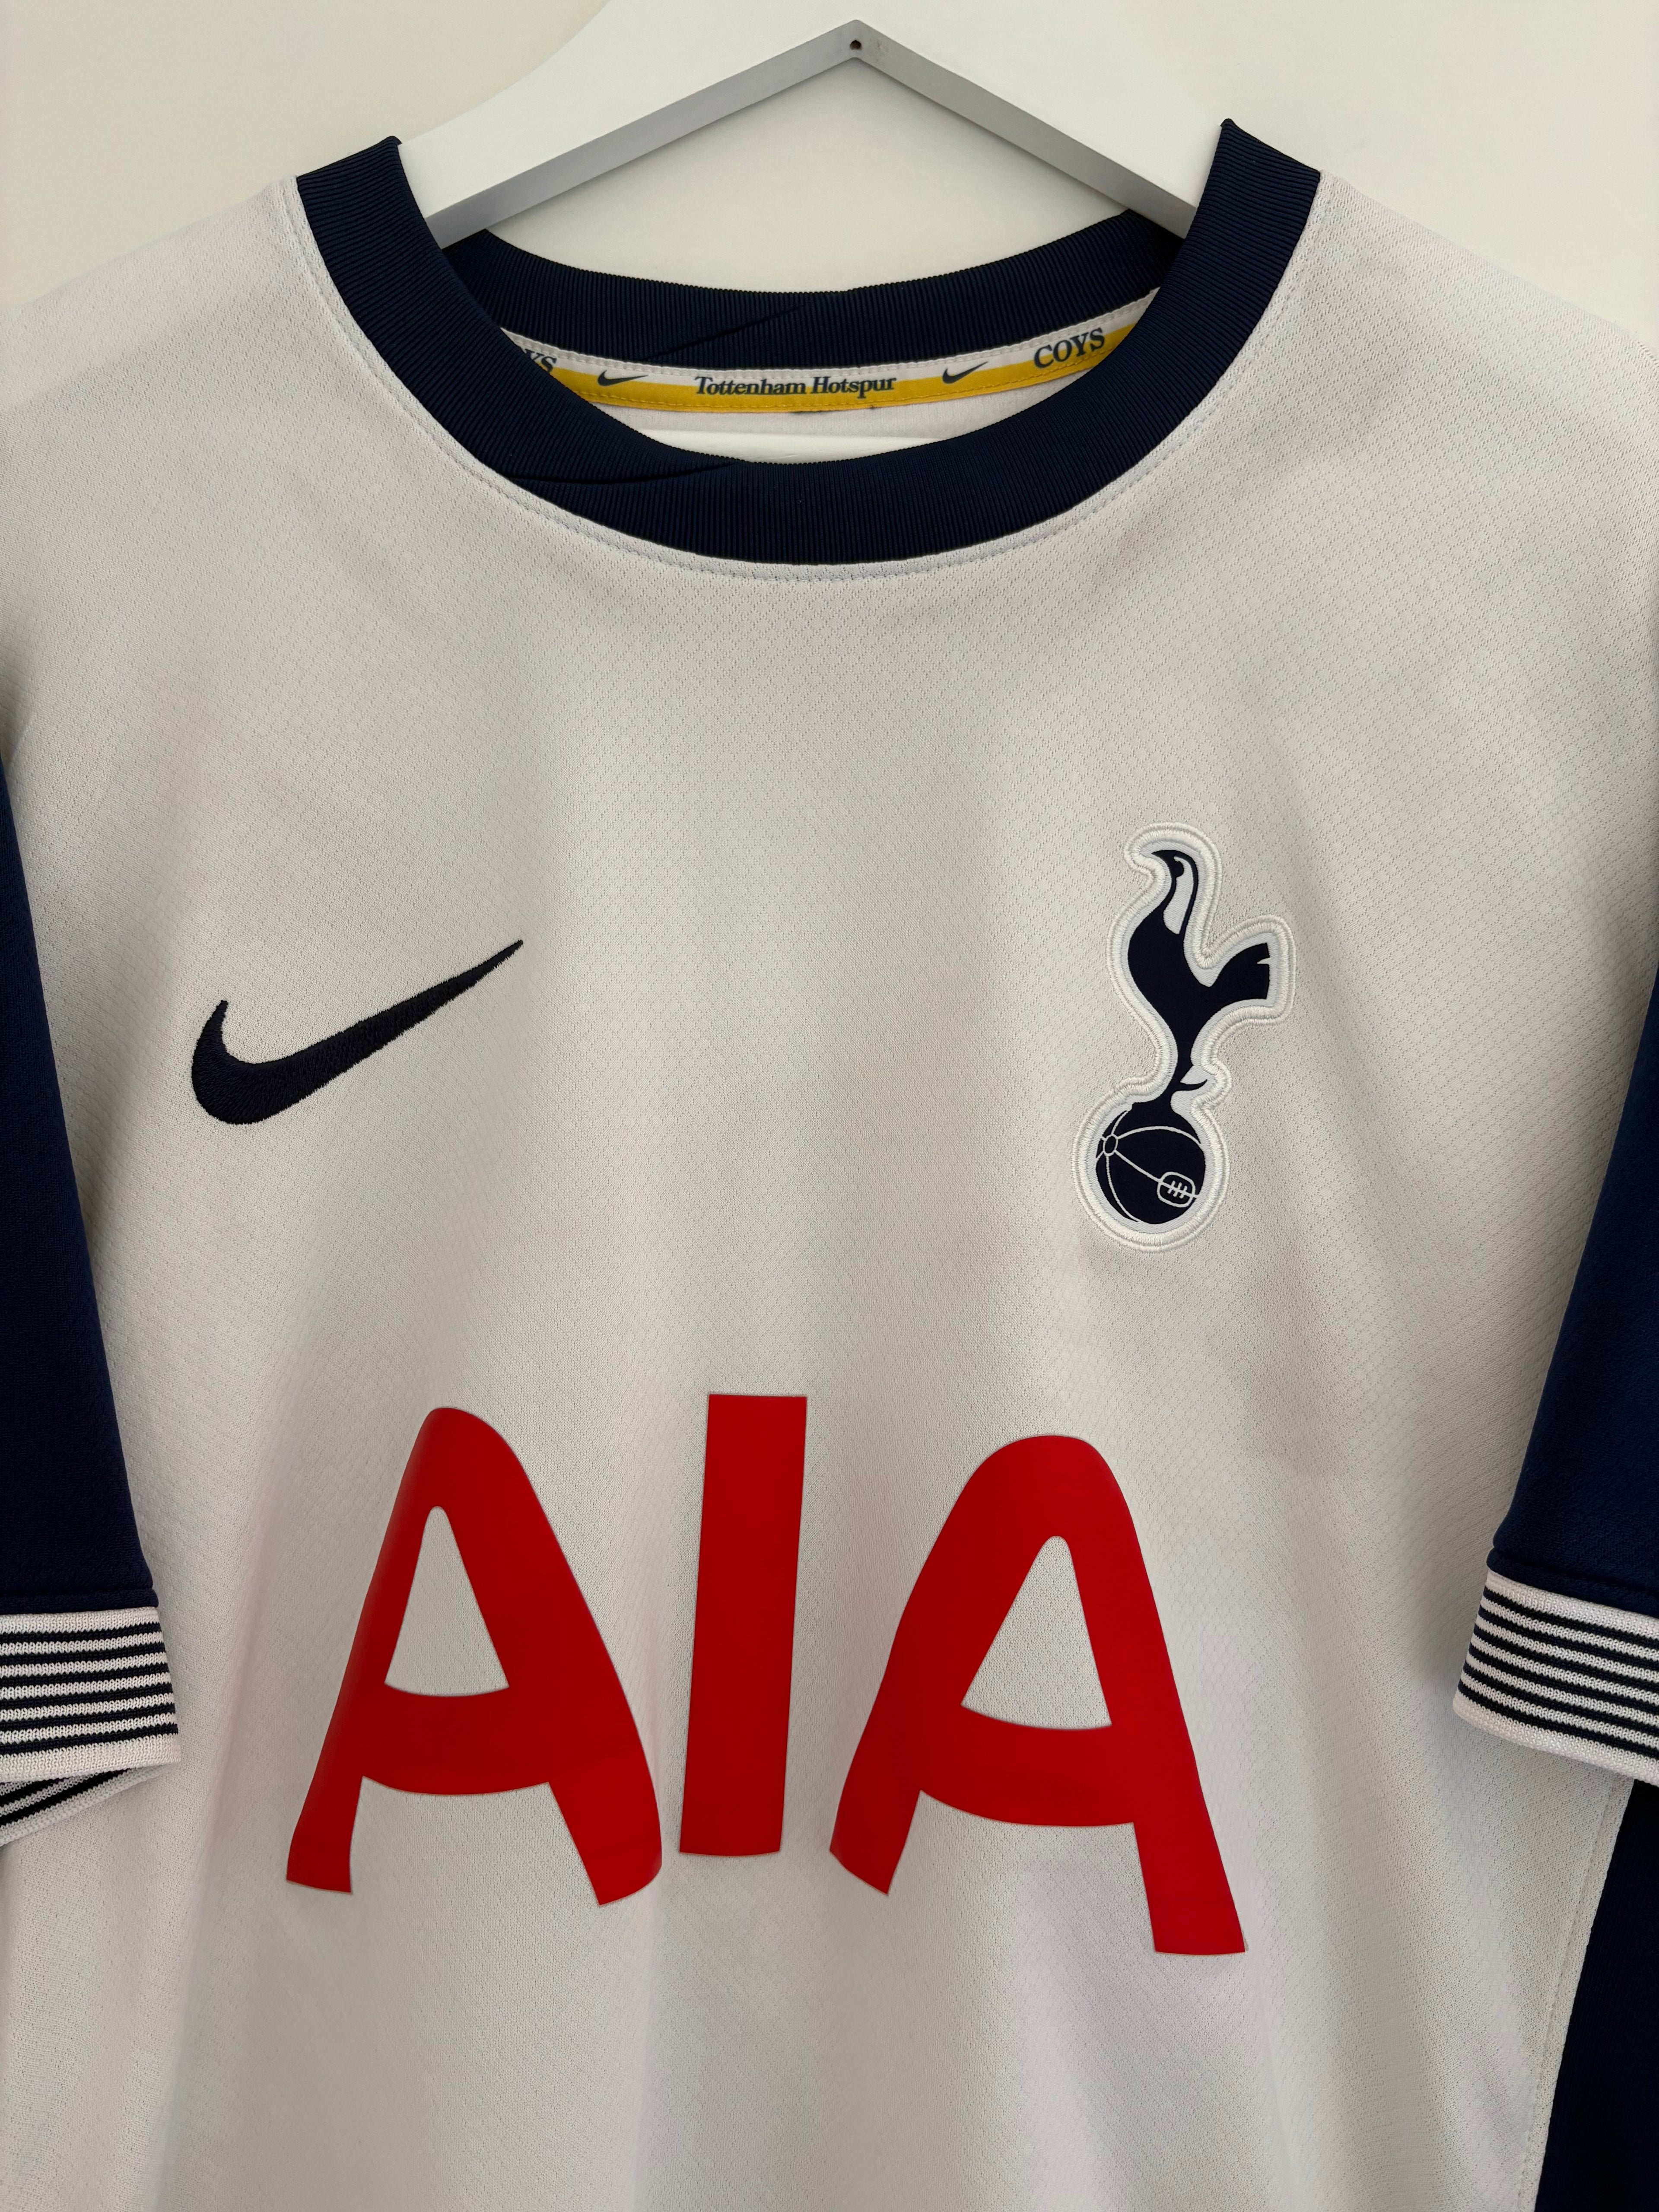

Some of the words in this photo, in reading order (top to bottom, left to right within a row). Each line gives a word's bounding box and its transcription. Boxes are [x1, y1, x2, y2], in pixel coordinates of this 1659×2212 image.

[1033, 327, 1106, 369] COYS
[694, 376, 807, 395] Tottenham
[810, 375, 897, 399] Hotspur
[286, 1393, 1246, 1956] AIA
